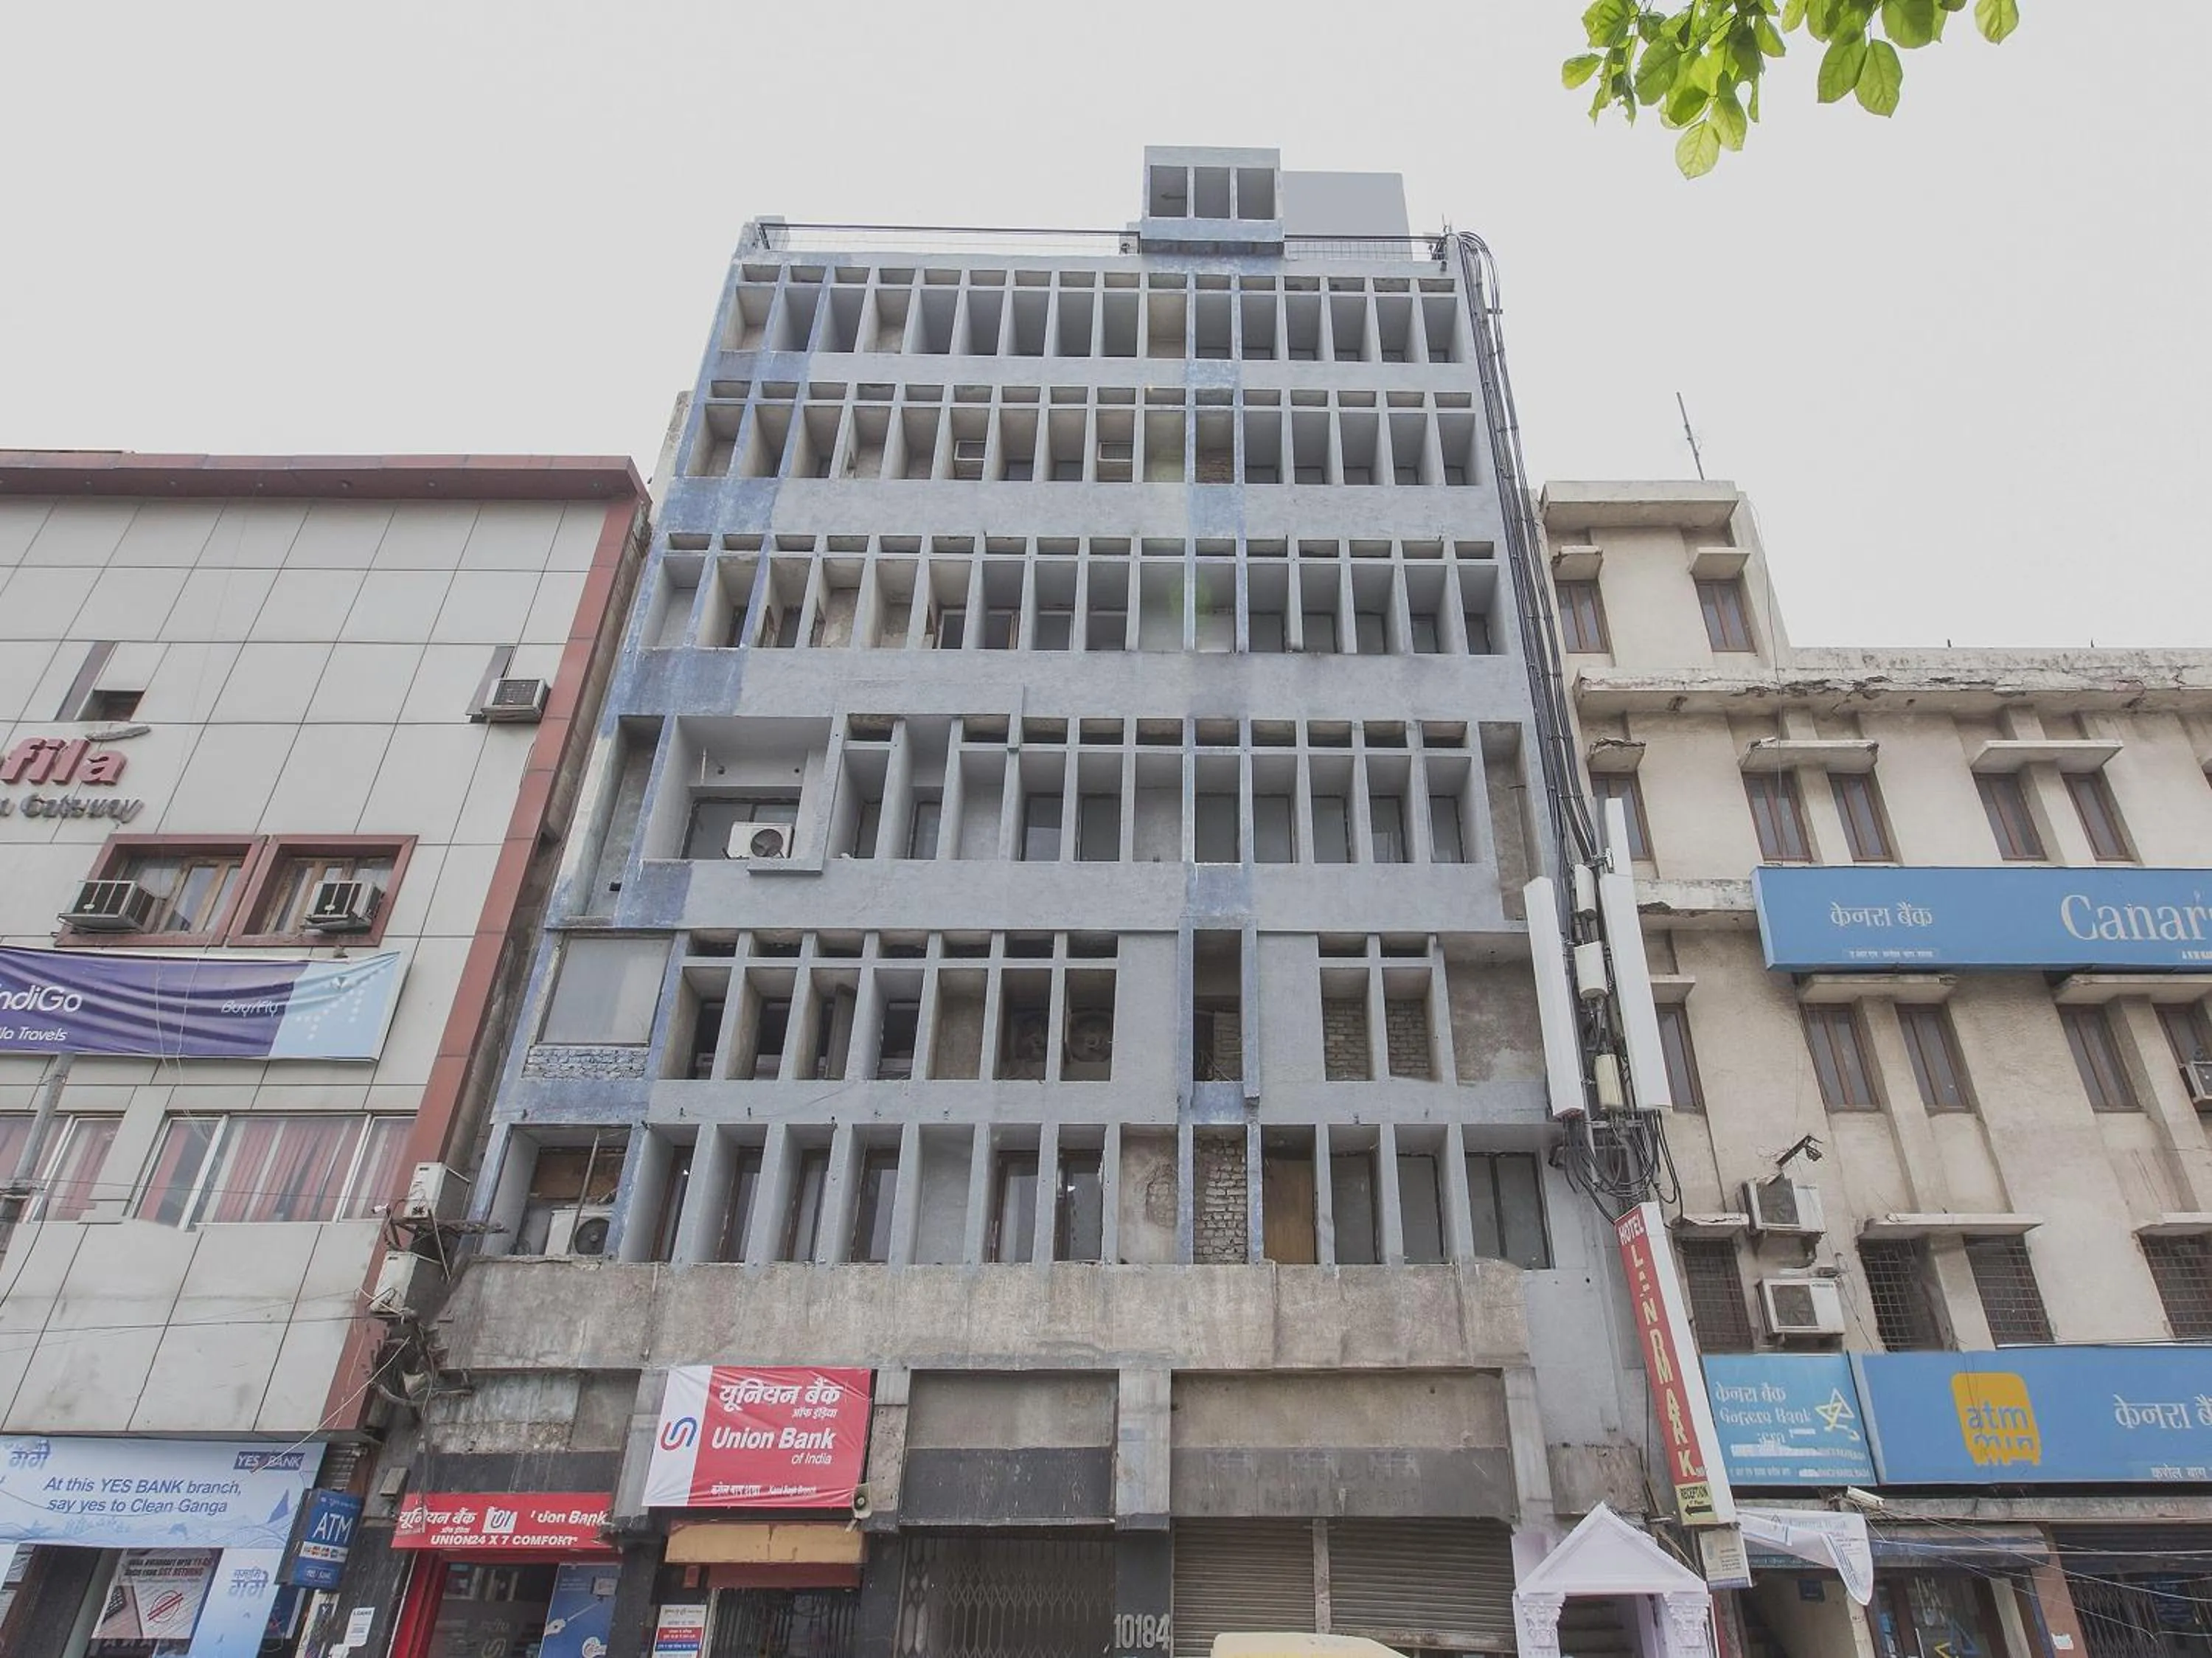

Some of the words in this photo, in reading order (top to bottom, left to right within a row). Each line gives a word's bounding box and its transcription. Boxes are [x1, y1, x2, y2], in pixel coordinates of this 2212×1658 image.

[0, 738, 127, 785] fila
[2061, 894, 2212, 941] Canar
[0, 983, 83, 1013] ndiGo
[18, 1026, 68, 1041] Travels
[718, 1378, 803, 1413] यूनियन
[804, 1376, 844, 1405] बैंक
[1966, 1399, 2029, 1430] atm
[2112, 1393, 2194, 1429] केनरा
[712, 1426, 775, 1450] Union
[779, 1426, 837, 1450] Bank
[238, 1454, 261, 1467] YES
[268, 1456, 302, 1468] BANK
[791, 1452, 802, 1465] of
[804, 1452, 833, 1465] India
[43, 1477, 63, 1491] At
[66, 1477, 95, 1492] this
[100, 1478, 133, 1494] YES
[135, 1479, 184, 1494] BANK
[186, 1480, 242, 1496] branch,
[47, 1498, 77, 1514] say
[80, 1499, 107, 1514] yes
[111, 1497, 126, 1512] to
[131, 1498, 173, 1513] Clean
[178, 1499, 228, 1516] Ganga
[311, 1511, 354, 1544] ATM
[487, 1535, 498, 1545] X
[501, 1535, 511, 1545] 7
[1113, 1614, 1170, 1651] 10184
